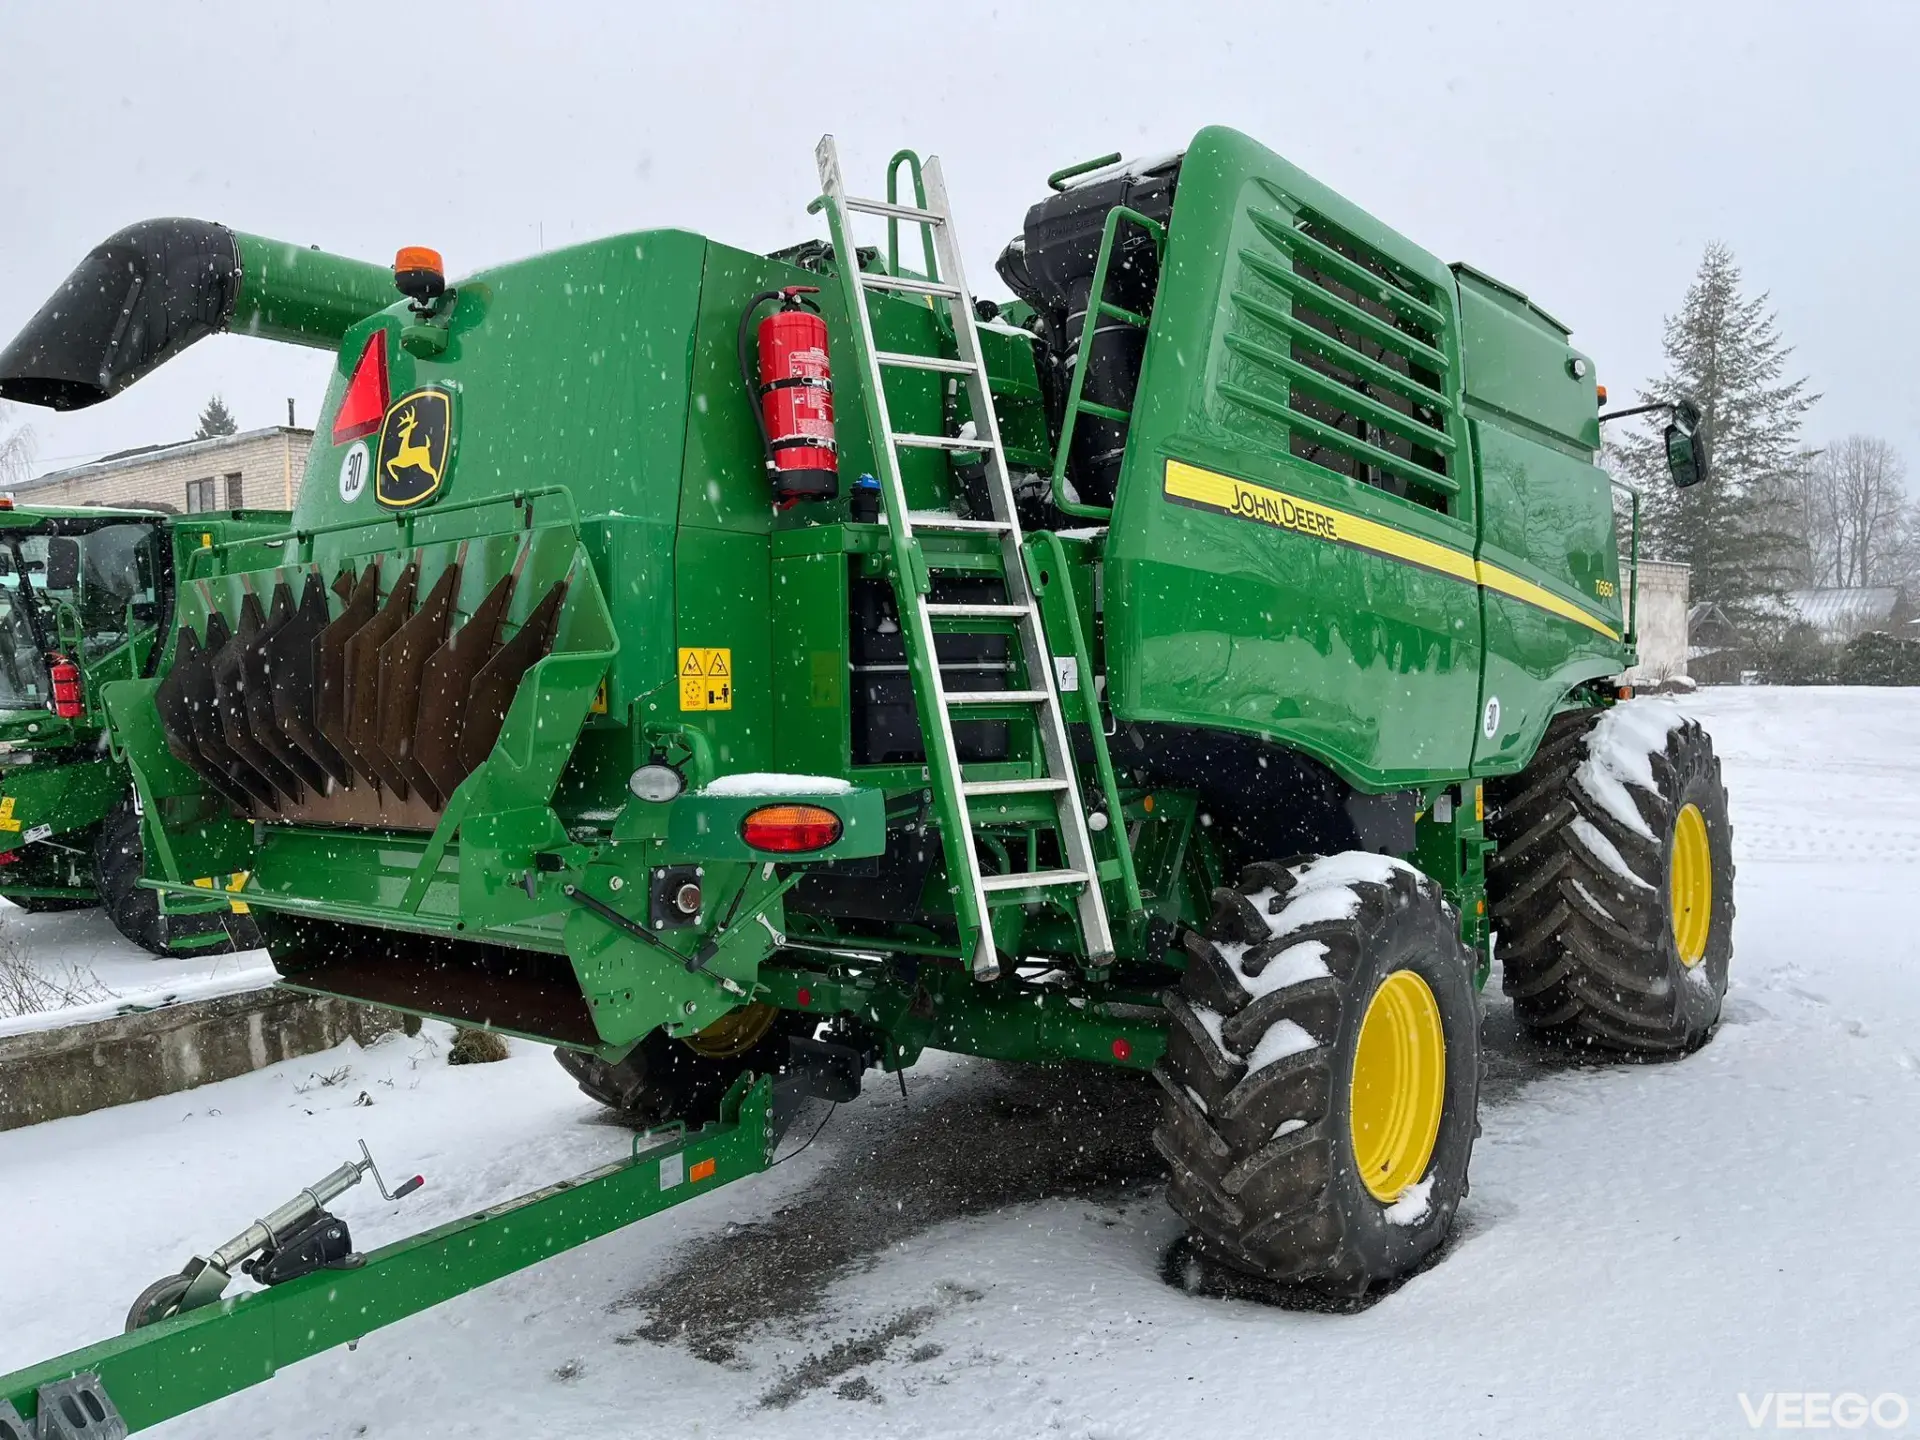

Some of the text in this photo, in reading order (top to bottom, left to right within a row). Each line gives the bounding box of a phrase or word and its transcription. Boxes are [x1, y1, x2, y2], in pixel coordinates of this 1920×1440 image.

[345, 452, 362, 492] 30
[1231, 484, 1338, 538] JOHN DEERE
[1595, 579, 1613, 597] T660
[1487, 704, 1497, 731] 30
